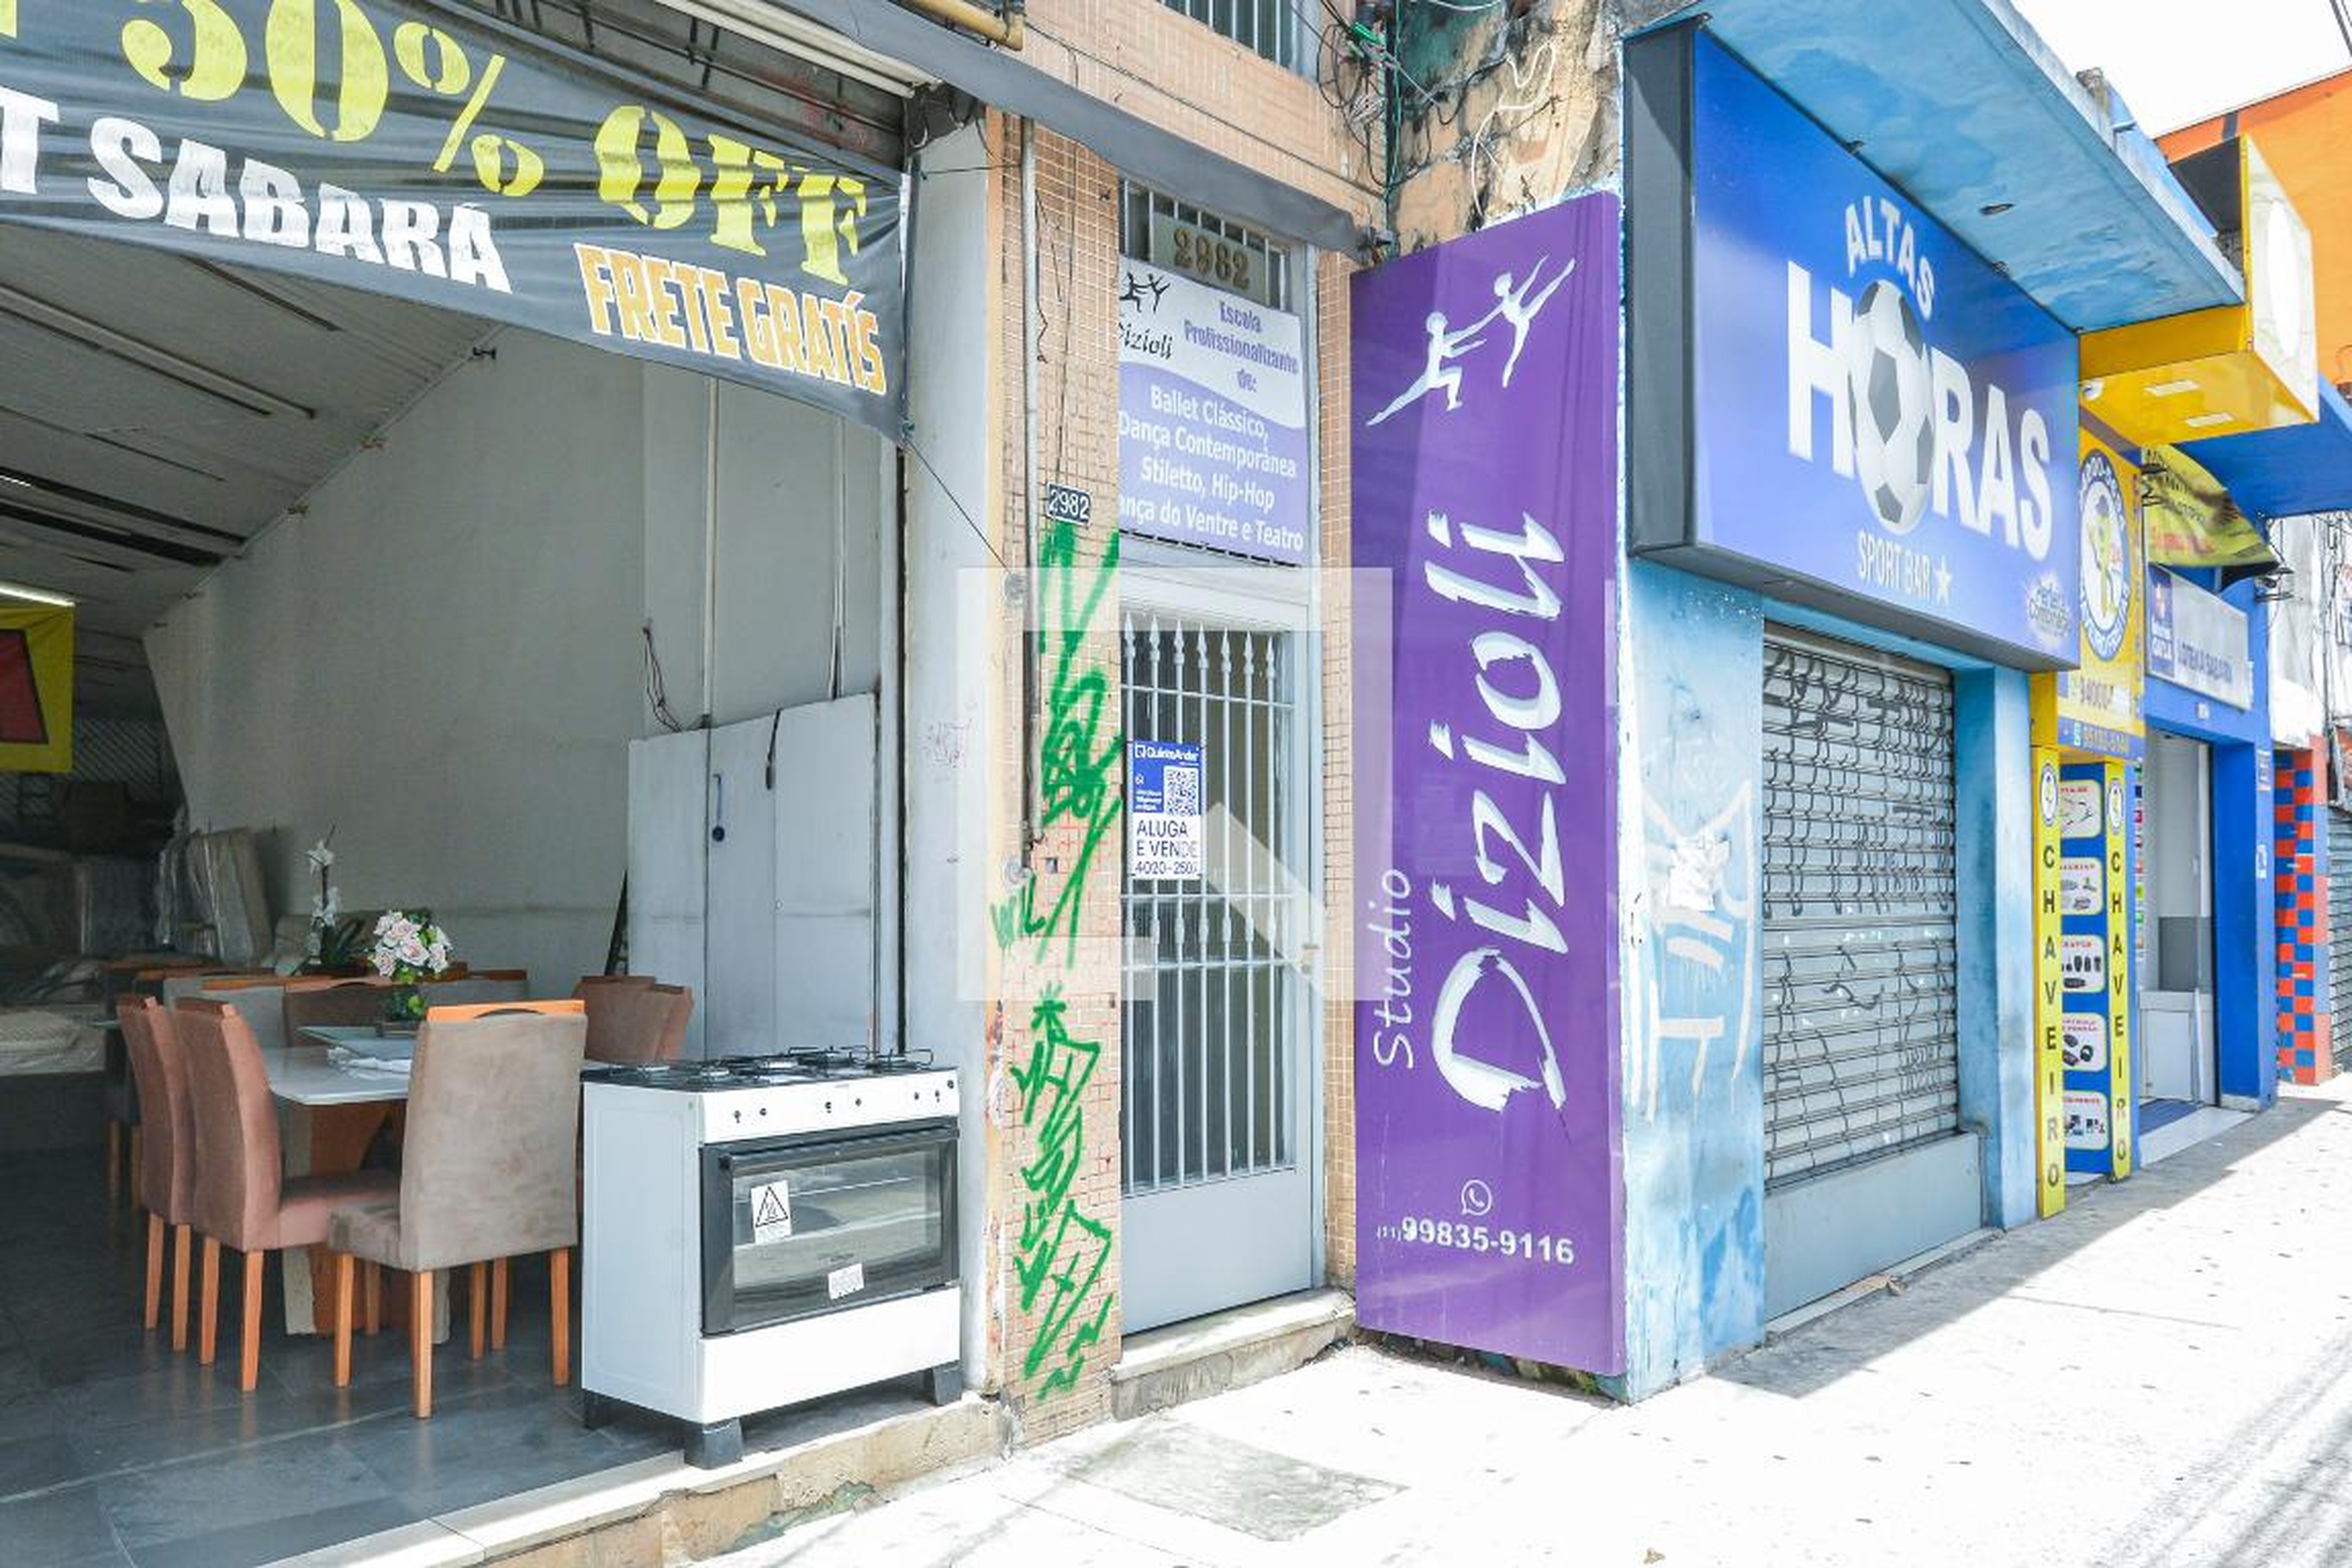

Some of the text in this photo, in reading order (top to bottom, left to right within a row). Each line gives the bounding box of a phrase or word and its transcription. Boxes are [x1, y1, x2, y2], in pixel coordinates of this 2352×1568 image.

[87, 118, 513, 295] SABARÁ
[594, 105, 867, 287] OFF
[1174, 228, 1250, 290] 2982
[1844, 195, 1935, 321] ALTAS
[573, 243, 887, 395] FRETE GRATÍS
[1219, 300, 1262, 333] Escola
[1150, 385, 1199, 422] Ballet
[1787, 260, 2054, 562] HORAS
[1118, 410, 1297, 478] Dança Contemporânea
[1049, 489, 1089, 519] 2982
[1141, 456, 1275, 513] Stiletto, Hip-Hop
[1119, 494, 1303, 551] ança do Ventre e Teatro
[1858, 529, 1931, 603] SPORT BAR
[1136, 820, 1189, 838] ALUGA
[1424, 511, 1568, 1112] Dizioli
[1136, 840, 1198, 859] E VENDE
[1367, 869, 1414, 1070] Studio
[2110, 851, 2127, 1161] CHAVEIRO
[2043, 845, 2059, 1187] CHAVEIRO
